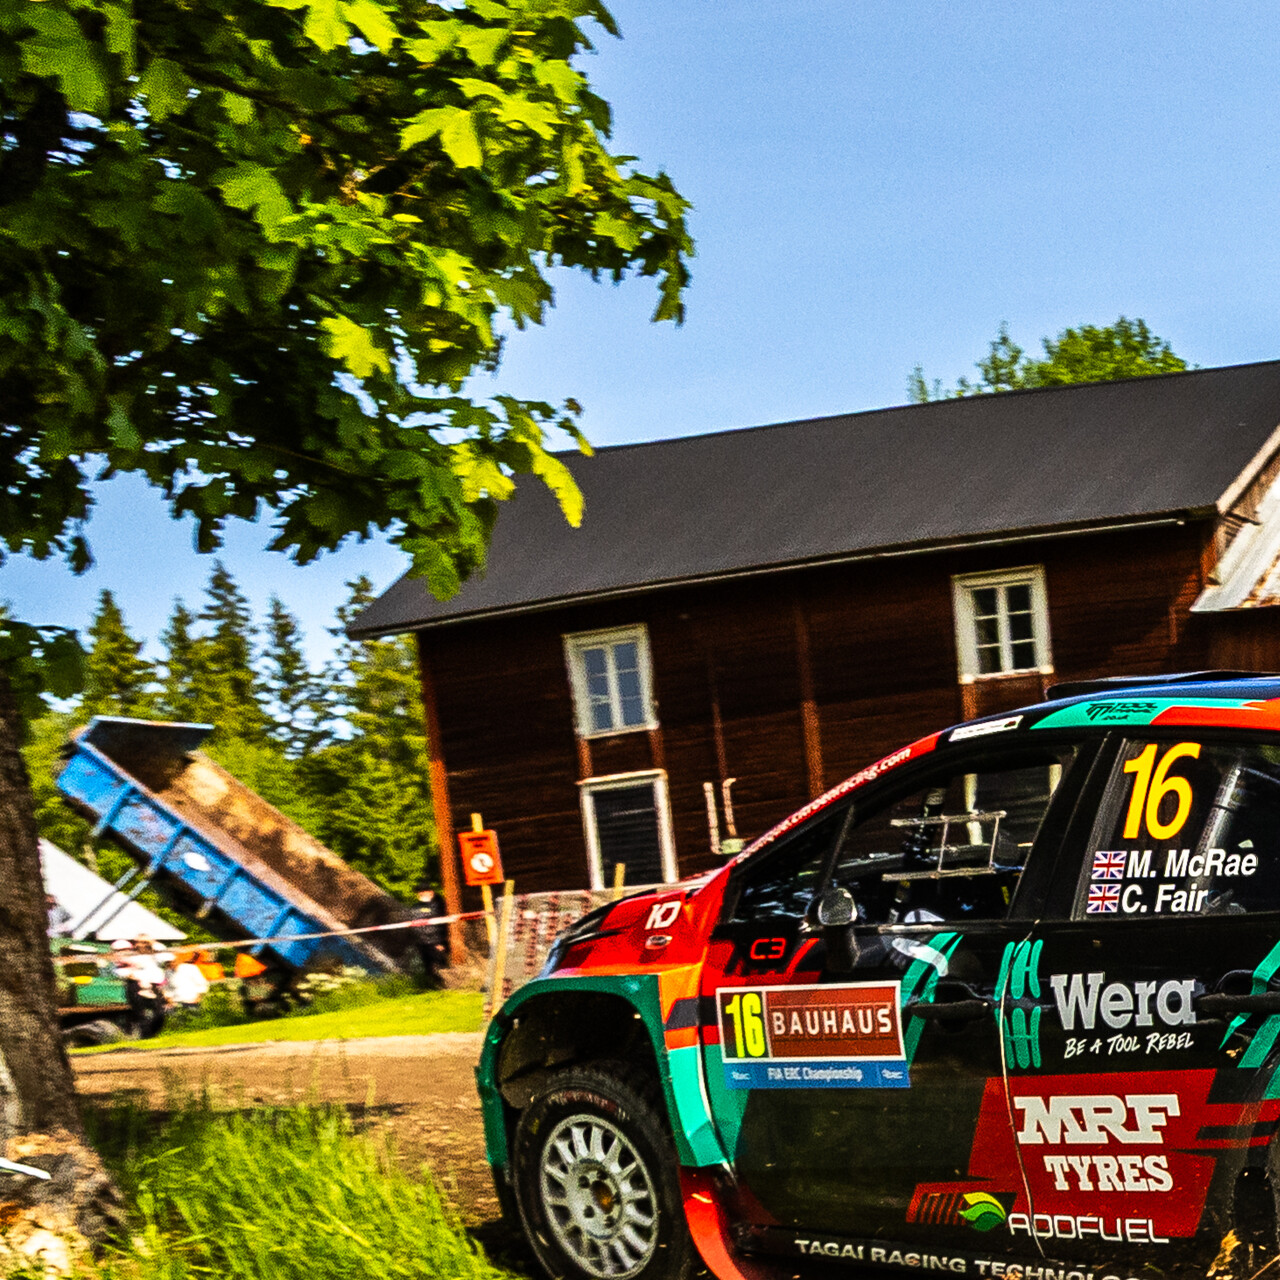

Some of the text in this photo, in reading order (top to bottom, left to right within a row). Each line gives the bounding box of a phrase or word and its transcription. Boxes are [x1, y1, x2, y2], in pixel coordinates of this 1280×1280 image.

[1123, 742, 1201, 840] 16
[1126, 848, 1258, 878] M. McRae
[1121, 882, 1209, 913] C. Fair
[750, 937, 786, 960] C3
[1050, 972, 1197, 1030] Wera
[725, 993, 766, 1059] 16
[773, 1005, 893, 1036] BAUHAUS
[1064, 1032, 1195, 1059] BE A TOOL REBEL
[1013, 1094, 1181, 1144] MRF
[1043, 1155, 1174, 1192] TYRES
[1007, 1212, 1170, 1244] ADDFUEL
[795, 1239, 865, 1261] TAGAI
[870, 1246, 967, 1274] RACING
